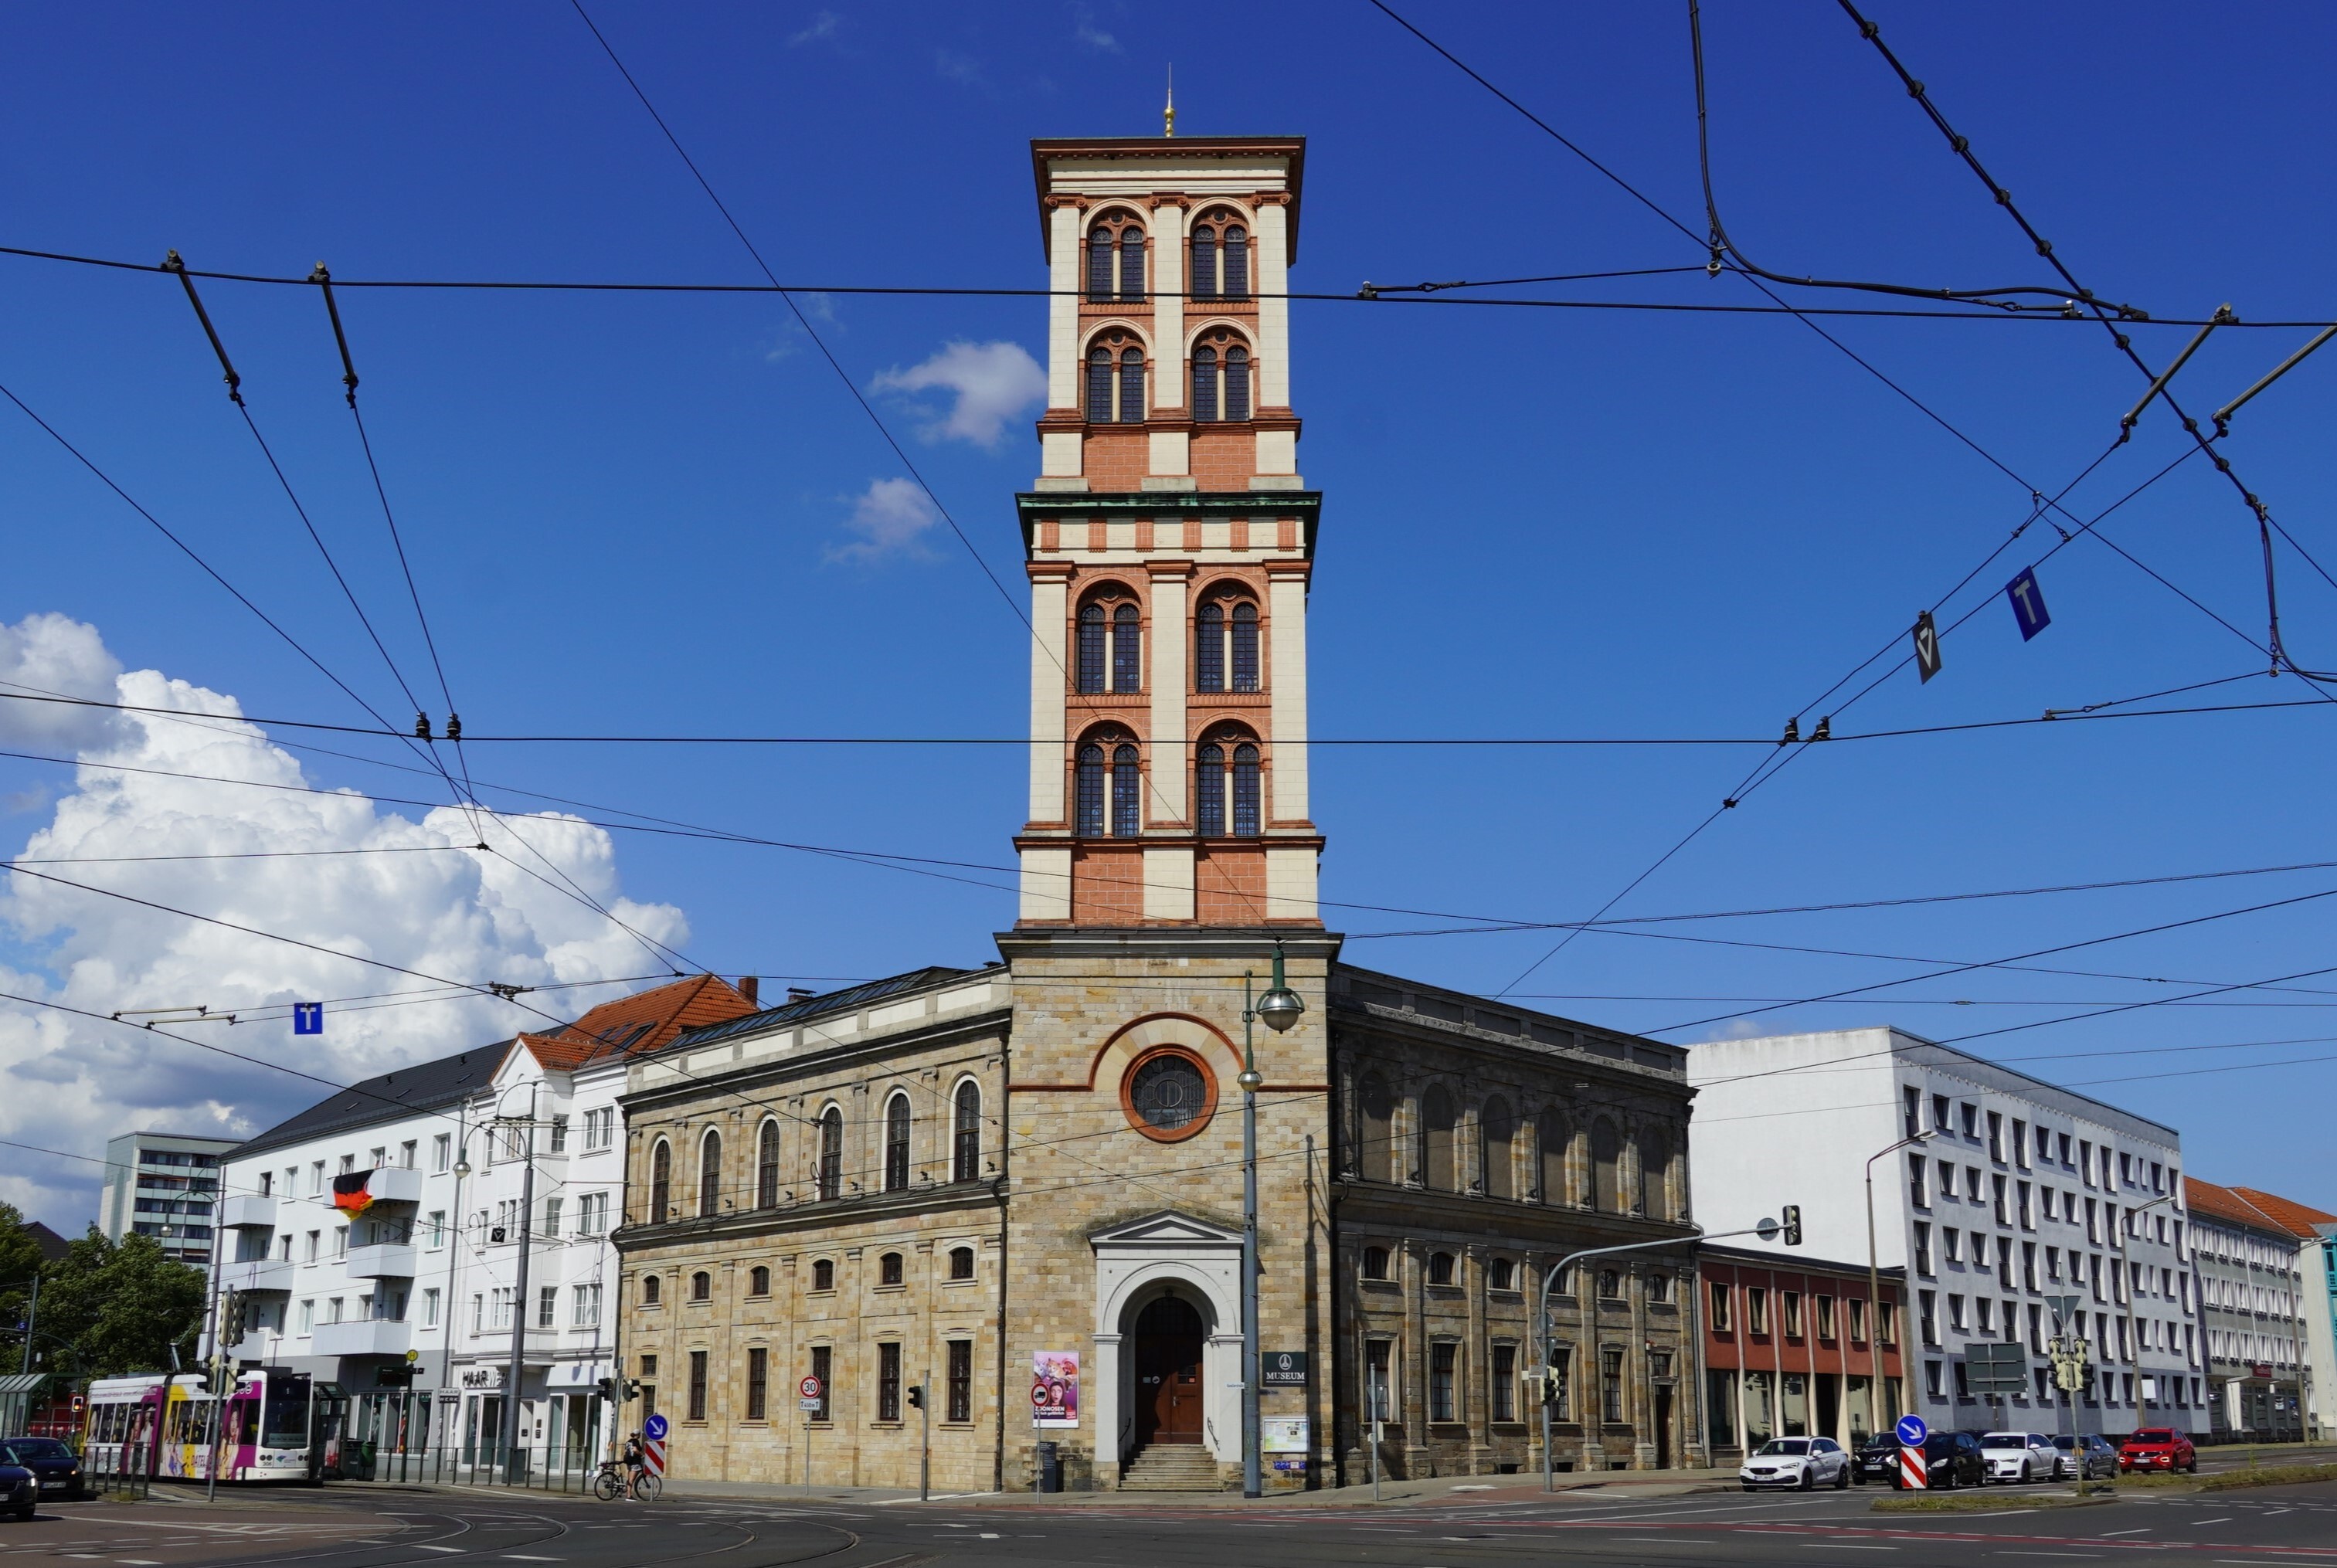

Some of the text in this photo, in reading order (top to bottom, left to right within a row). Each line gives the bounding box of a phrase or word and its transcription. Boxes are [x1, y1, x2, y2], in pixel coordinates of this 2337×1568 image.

[2013, 579, 2036, 625] T
[300, 1007, 317, 1030] T
[1266, 1372, 1306, 1380] MUSEUM
[804, 1382, 816, 1392] 30
